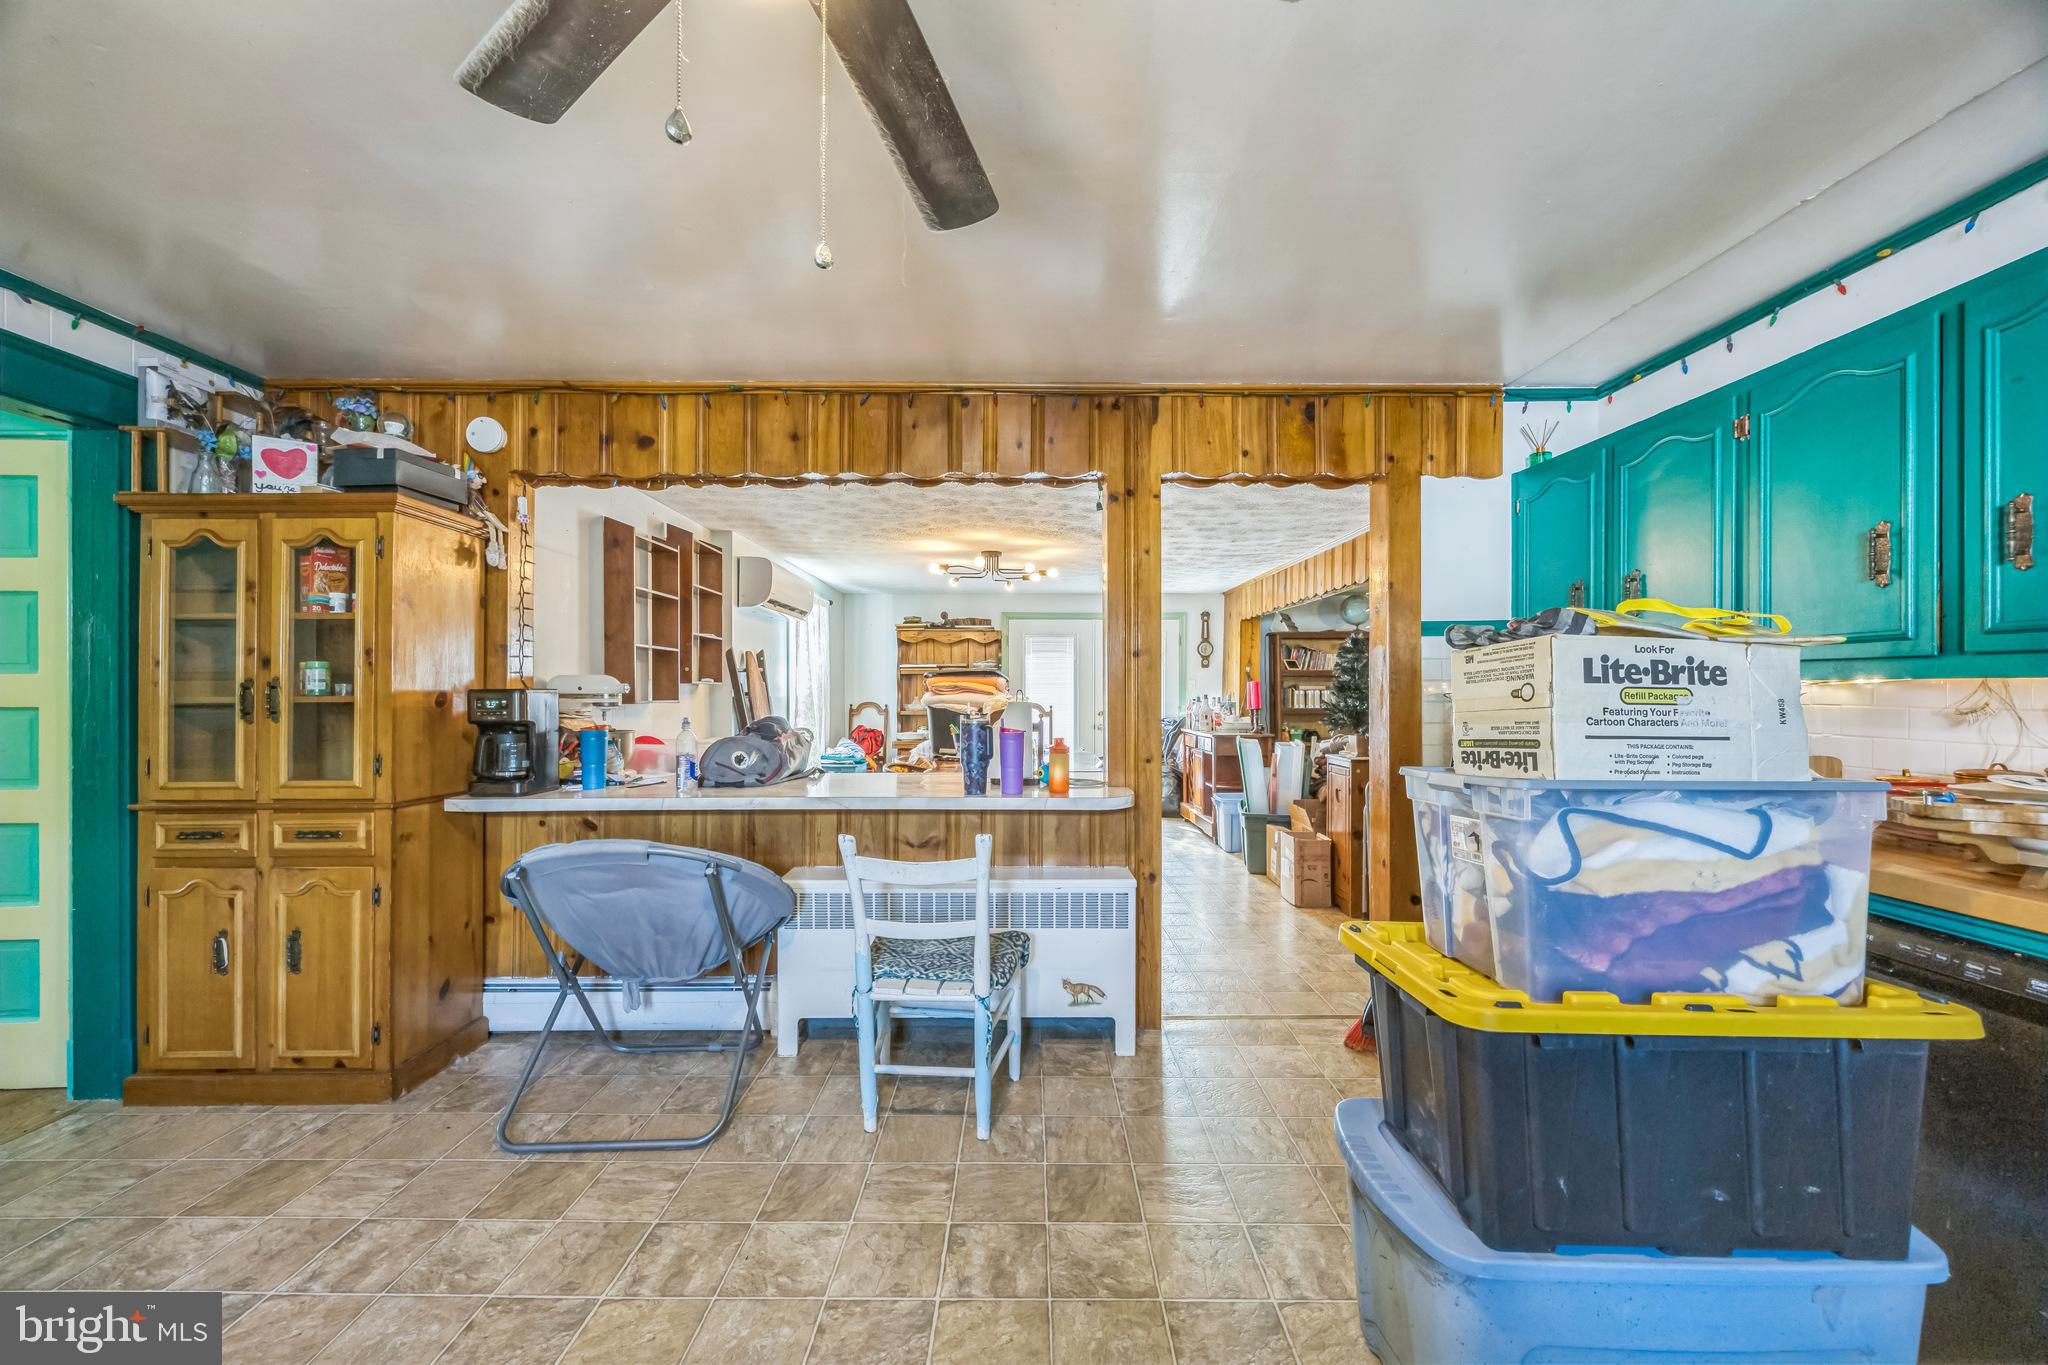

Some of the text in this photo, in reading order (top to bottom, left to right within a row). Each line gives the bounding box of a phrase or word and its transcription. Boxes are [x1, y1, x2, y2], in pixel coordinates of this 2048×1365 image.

[1634, 645, 1674, 654] Look For
[1505, 673, 1534, 681] WARNING:
[1624, 691, 1646, 700] Refill
[1602, 707, 1648, 718] Featuring
[1650, 708, 1672, 716] Your
[1586, 717, 1625, 726] Cartoon
[1627, 718, 1678, 726] Characters
